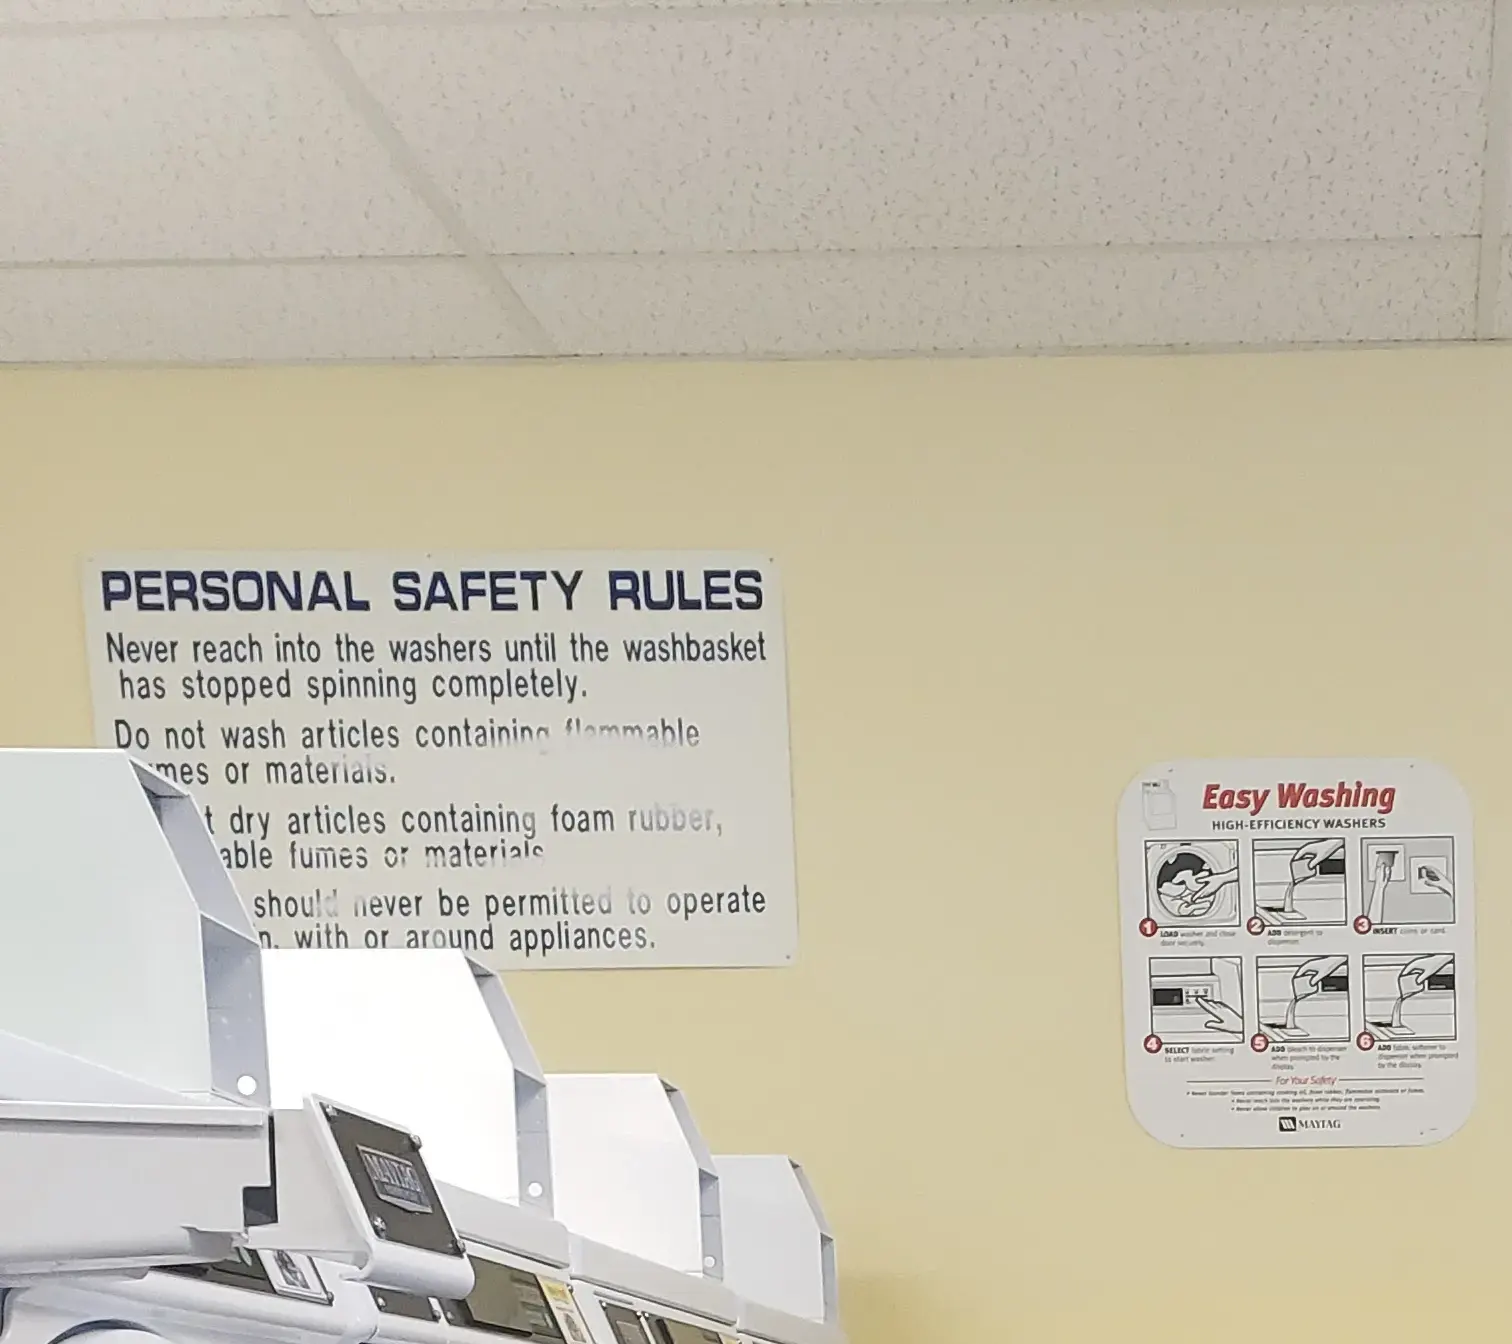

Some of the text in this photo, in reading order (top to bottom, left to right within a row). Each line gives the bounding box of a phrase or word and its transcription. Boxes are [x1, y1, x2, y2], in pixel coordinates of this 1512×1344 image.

[101, 569, 763, 611] PERSONAL SAFETY RULES
[106, 632, 766, 663] Never reach into the washers until the washbasket
[119, 668, 587, 705] has stopped spinning completely.
[114, 719, 149, 750] Do
[165, 720, 206, 749] not
[221, 720, 286, 749] wash
[301, 718, 400, 749] articles
[415, 718, 549, 754] containing
[148, 755, 395, 785] mes or materials.
[1203, 781, 1396, 816] Easy Washing
[230, 805, 269, 840] dry
[288, 804, 386, 834] articles
[402, 802, 536, 839] containing
[551, 803, 615, 832] foam
[628, 803, 722, 837] rubber,
[1212, 818, 1385, 830] HIGH-EFFICIENCY WASHERS
[290, 841, 369, 869] fumes
[384, 846, 408, 868] or
[254, 885, 766, 921] should never be permitted to operate
[294, 923, 349, 949] with
[364, 929, 389, 949] or
[406, 923, 494, 951] around
[509, 921, 655, 957] appliances.
[1276, 1076, 1337, 1085] For Your Safety
[1298, 1119, 1341, 1129] MAYTAG
